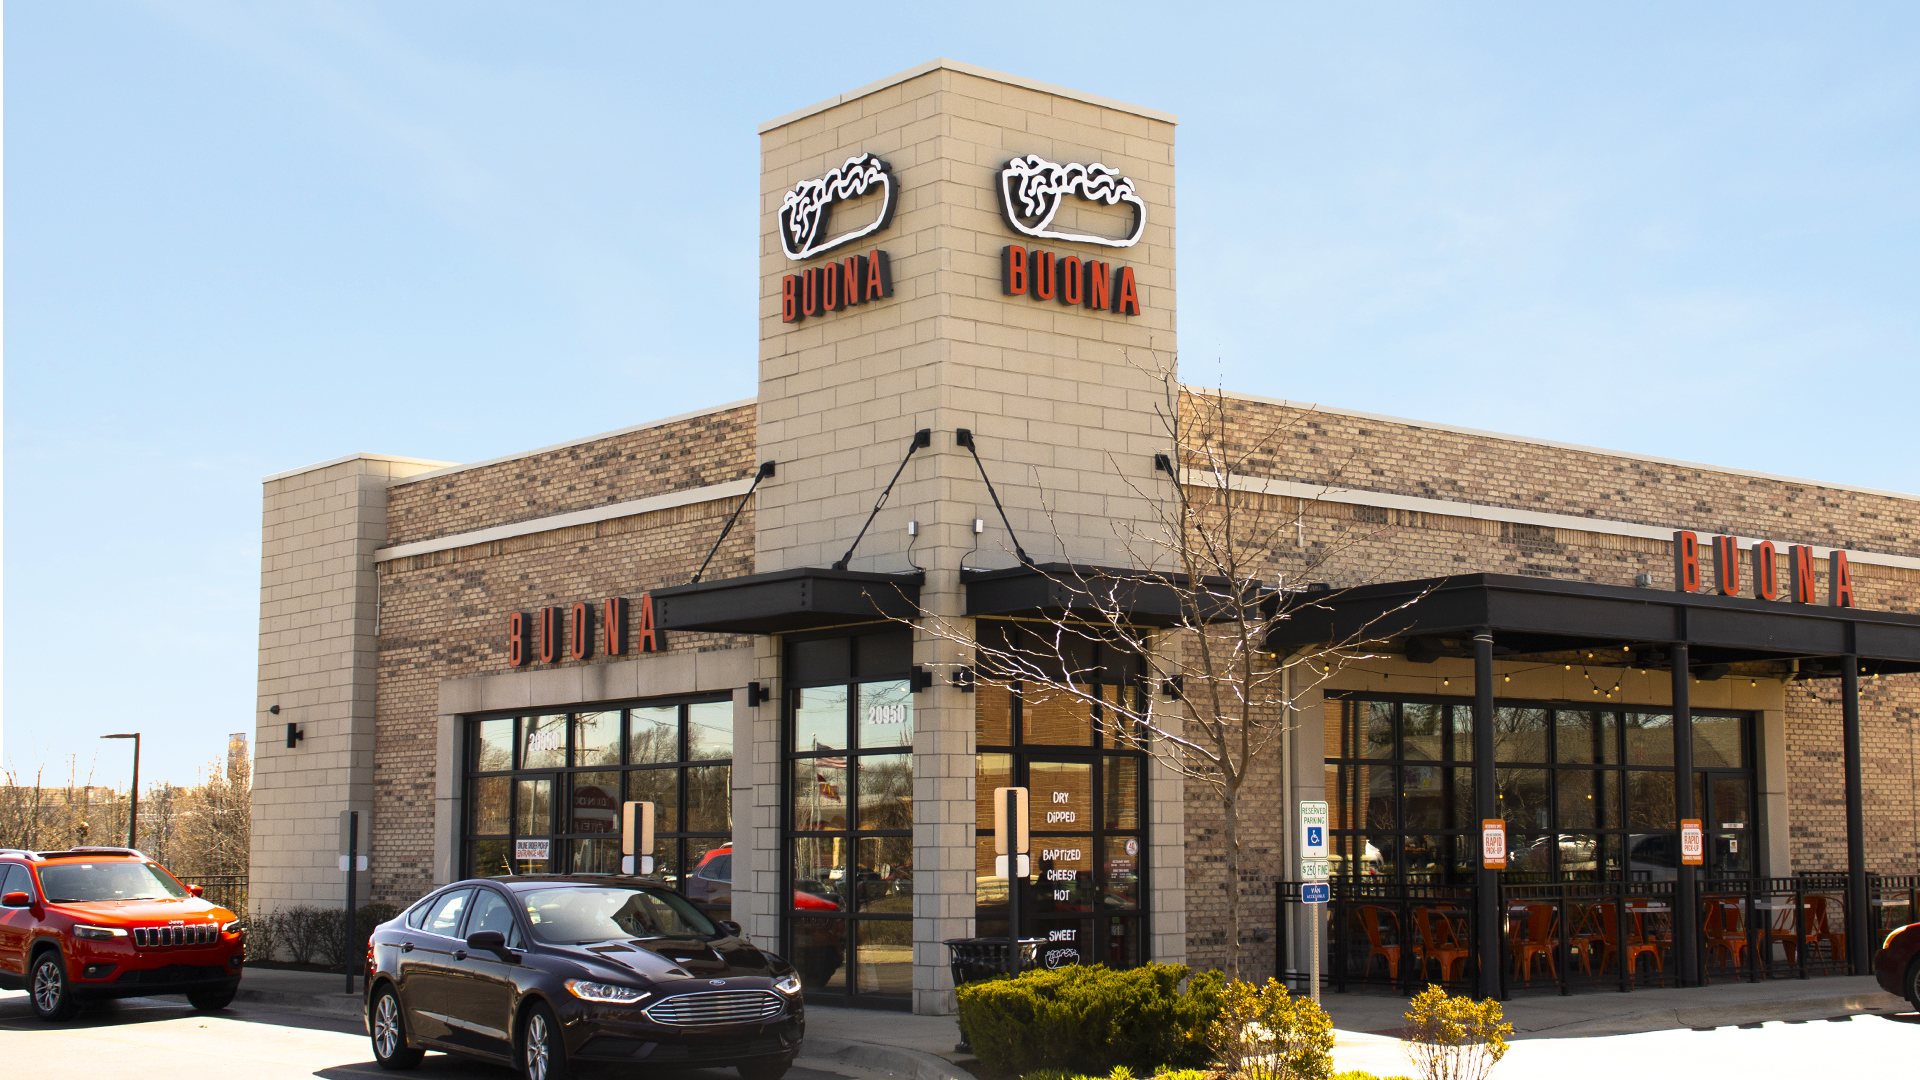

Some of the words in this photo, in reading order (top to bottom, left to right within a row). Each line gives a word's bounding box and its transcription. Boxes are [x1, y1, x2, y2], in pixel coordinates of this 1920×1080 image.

[782, 249, 888, 323] BUONA
[1004, 244, 1141, 316] BUONA
[1674, 530, 1855, 608] BUONA
[509, 593, 662, 667] BUONA
[868, 704, 905, 724] 20950
[528, 732, 559, 751] 20950
[1053, 791, 1069, 803] DRY
[1486, 836, 1502, 846] RAPID
[1684, 835, 1699, 844] RAPID
[1486, 846, 1502, 854] PICK-UP
[1047, 869, 1077, 881] CHEESY
[1318, 865, 1328, 875] FINE
[1053, 889, 1070, 901] HOT
[1048, 929, 1077, 942] SWEET
